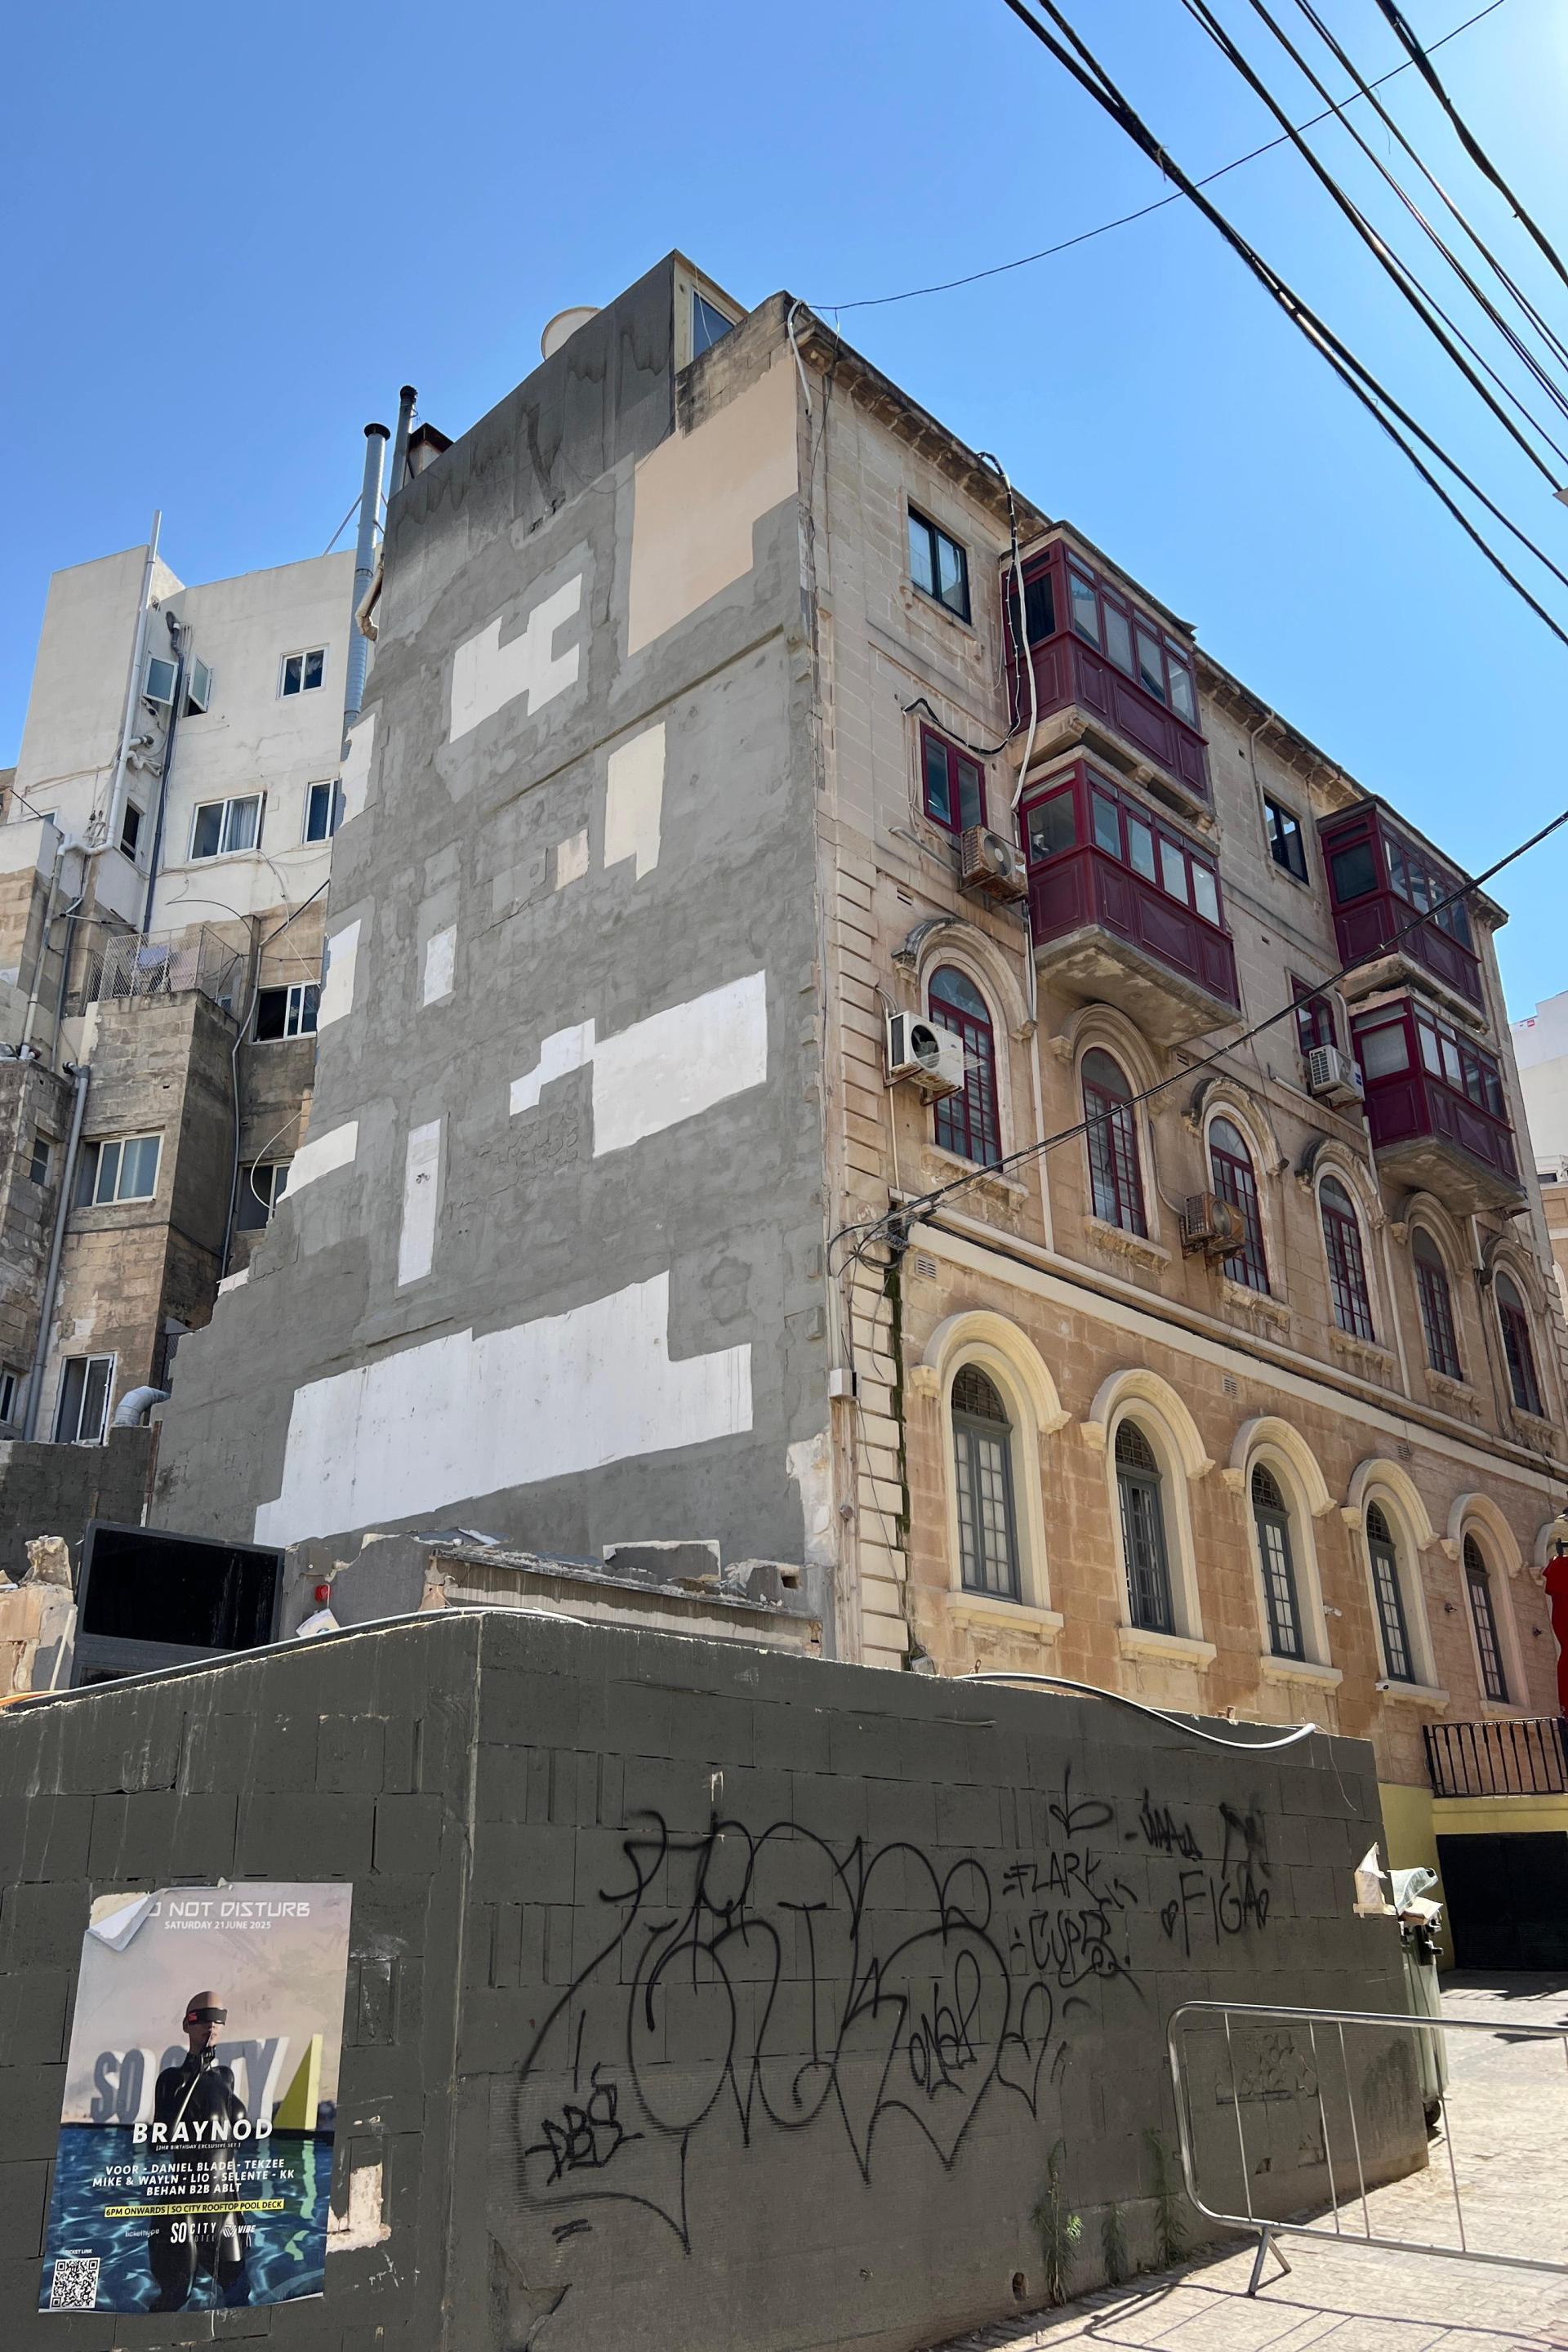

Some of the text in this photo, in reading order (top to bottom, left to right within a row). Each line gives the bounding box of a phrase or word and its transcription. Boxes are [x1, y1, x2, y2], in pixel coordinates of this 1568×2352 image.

[169, 1901, 214, 1917] NOT
[220, 1901, 310, 1917] DISTURB
[164, 1921, 212, 1930] SATURDAY
[250, 1920, 272, 1929] 2025
[90, 2048, 155, 2123] SO
[132, 2118, 273, 2144] BRAYNOD
[105, 2166, 139, 2176] VOOR
[151, 2163, 194, 2174] DANIEL
[196, 2161, 234, 2172] BLADE
[244, 2159, 285, 2170] TEKZEE
[92, 2177, 122, 2187] MIKE
[139, 2175, 179, 2185] WAYLN
[190, 2173, 210, 2183] LIO
[221, 2171, 269, 2182] SELENTE
[279, 2169, 295, 2179] KK
[146, 2183, 242, 2196] BEHAN B2B ABLT
[106, 2207, 122, 2216] 6PM
[124, 2206, 166, 2216] ONWARDS
[172, 2205, 181, 2214] SO
[184, 2204, 201, 2213] CITY
[203, 2203, 238, 2212] ROOFTOP
[240, 2202, 261, 2211] POOL
[262, 2201, 283, 2209] DECK
[170, 2221, 216, 2243] SO CITY
[238, 2225, 256, 2234] VIBE
